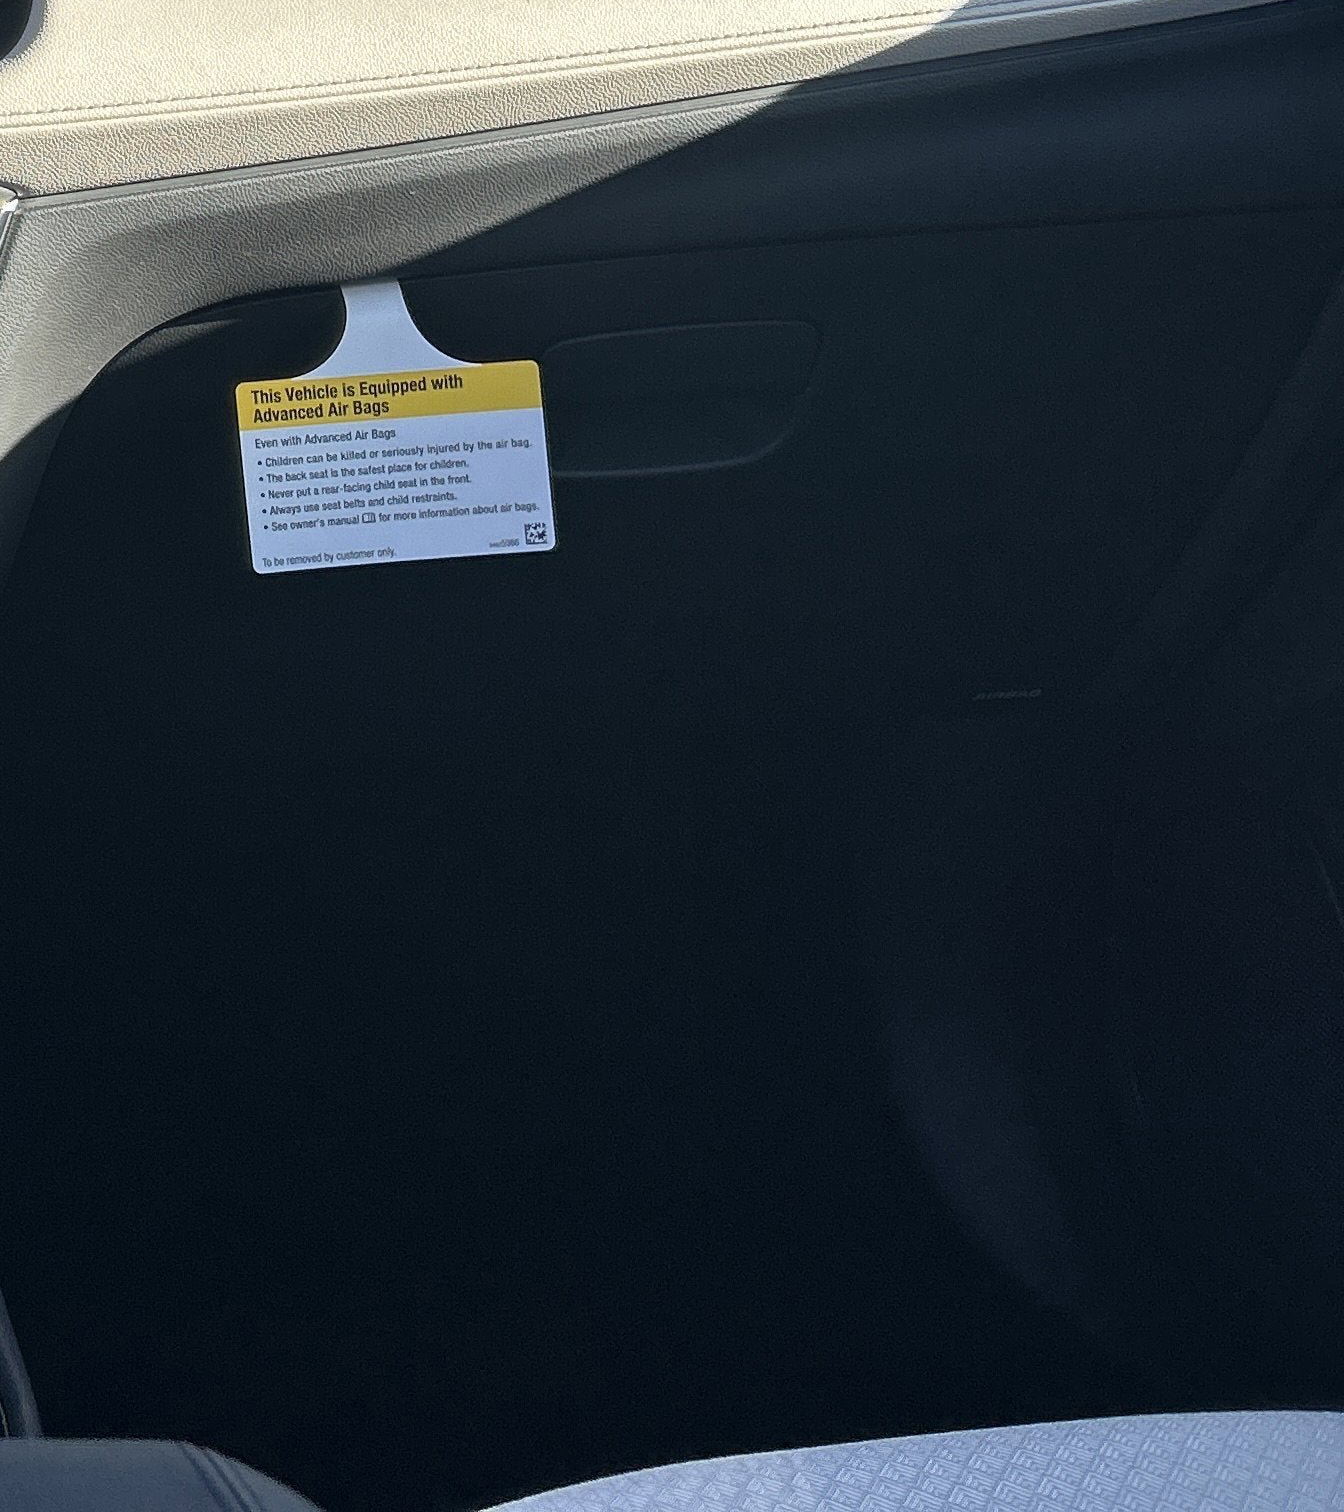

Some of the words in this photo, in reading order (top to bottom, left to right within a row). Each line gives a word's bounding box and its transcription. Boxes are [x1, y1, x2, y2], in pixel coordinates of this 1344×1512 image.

[250, 388, 281, 404] This
[284, 384, 337, 401] Vehicle
[342, 382, 354, 397] is
[359, 376, 426, 396] Equipped
[430, 373, 462, 389] with
[253, 403, 323, 423] Advanced
[327, 401, 348, 416] Air
[352, 400, 389, 416] Bags
[254, 438, 278, 448] Even
[280, 435, 301, 446] with
[304, 431, 352, 444] Advanced
[354, 430, 368, 440] Air
[371, 428, 396, 440] Bags
[265, 455, 303, 467] Children
[306, 455, 323, 463] can
[325, 452, 337, 462] be
[340, 449, 366, 460] killed
[369, 450, 378, 458] or
[381, 445, 423, 457] seriously
[426, 442, 460, 455] injured
[462, 441, 474, 452] by
[477, 440, 492, 450] the
[495, 439, 508, 448] air
[265, 473, 283, 483] The
[284, 470, 307, 481] back
[308, 469, 328, 479] seat
[340, 467, 355, 476] the
[357, 464, 385, 475] safest
[387, 463, 412, 474] place
[414, 461, 427, 470] for
[268, 489, 293, 499] Never
[296, 486, 311, 498] put
[321, 482, 371, 494] rear-facing
[373, 479, 395, 490] child
[397, 477, 417, 488] seat
[419, 477, 428, 486] in
[430, 476, 445, 485] the
[269, 505, 301, 515] Always
[303, 503, 319, 512] use
[321, 500, 341, 510] seat
[343, 498, 365, 508] belts
[368, 496, 384, 506] and
[386, 494, 408, 505] child
[271, 521, 287, 531] See
[327, 514, 359, 526] manual
[378, 512, 390, 522] for
[393, 512, 416, 520] more
[418, 506, 469, 518] information
[472, 504, 498, 514] about
[500, 502, 512, 512] air
[261, 557, 272, 567] To
[273, 556, 284, 566] be
[285, 552, 322, 565] removed
[323, 552, 333, 563] by
[335, 549, 374, 560] customer
